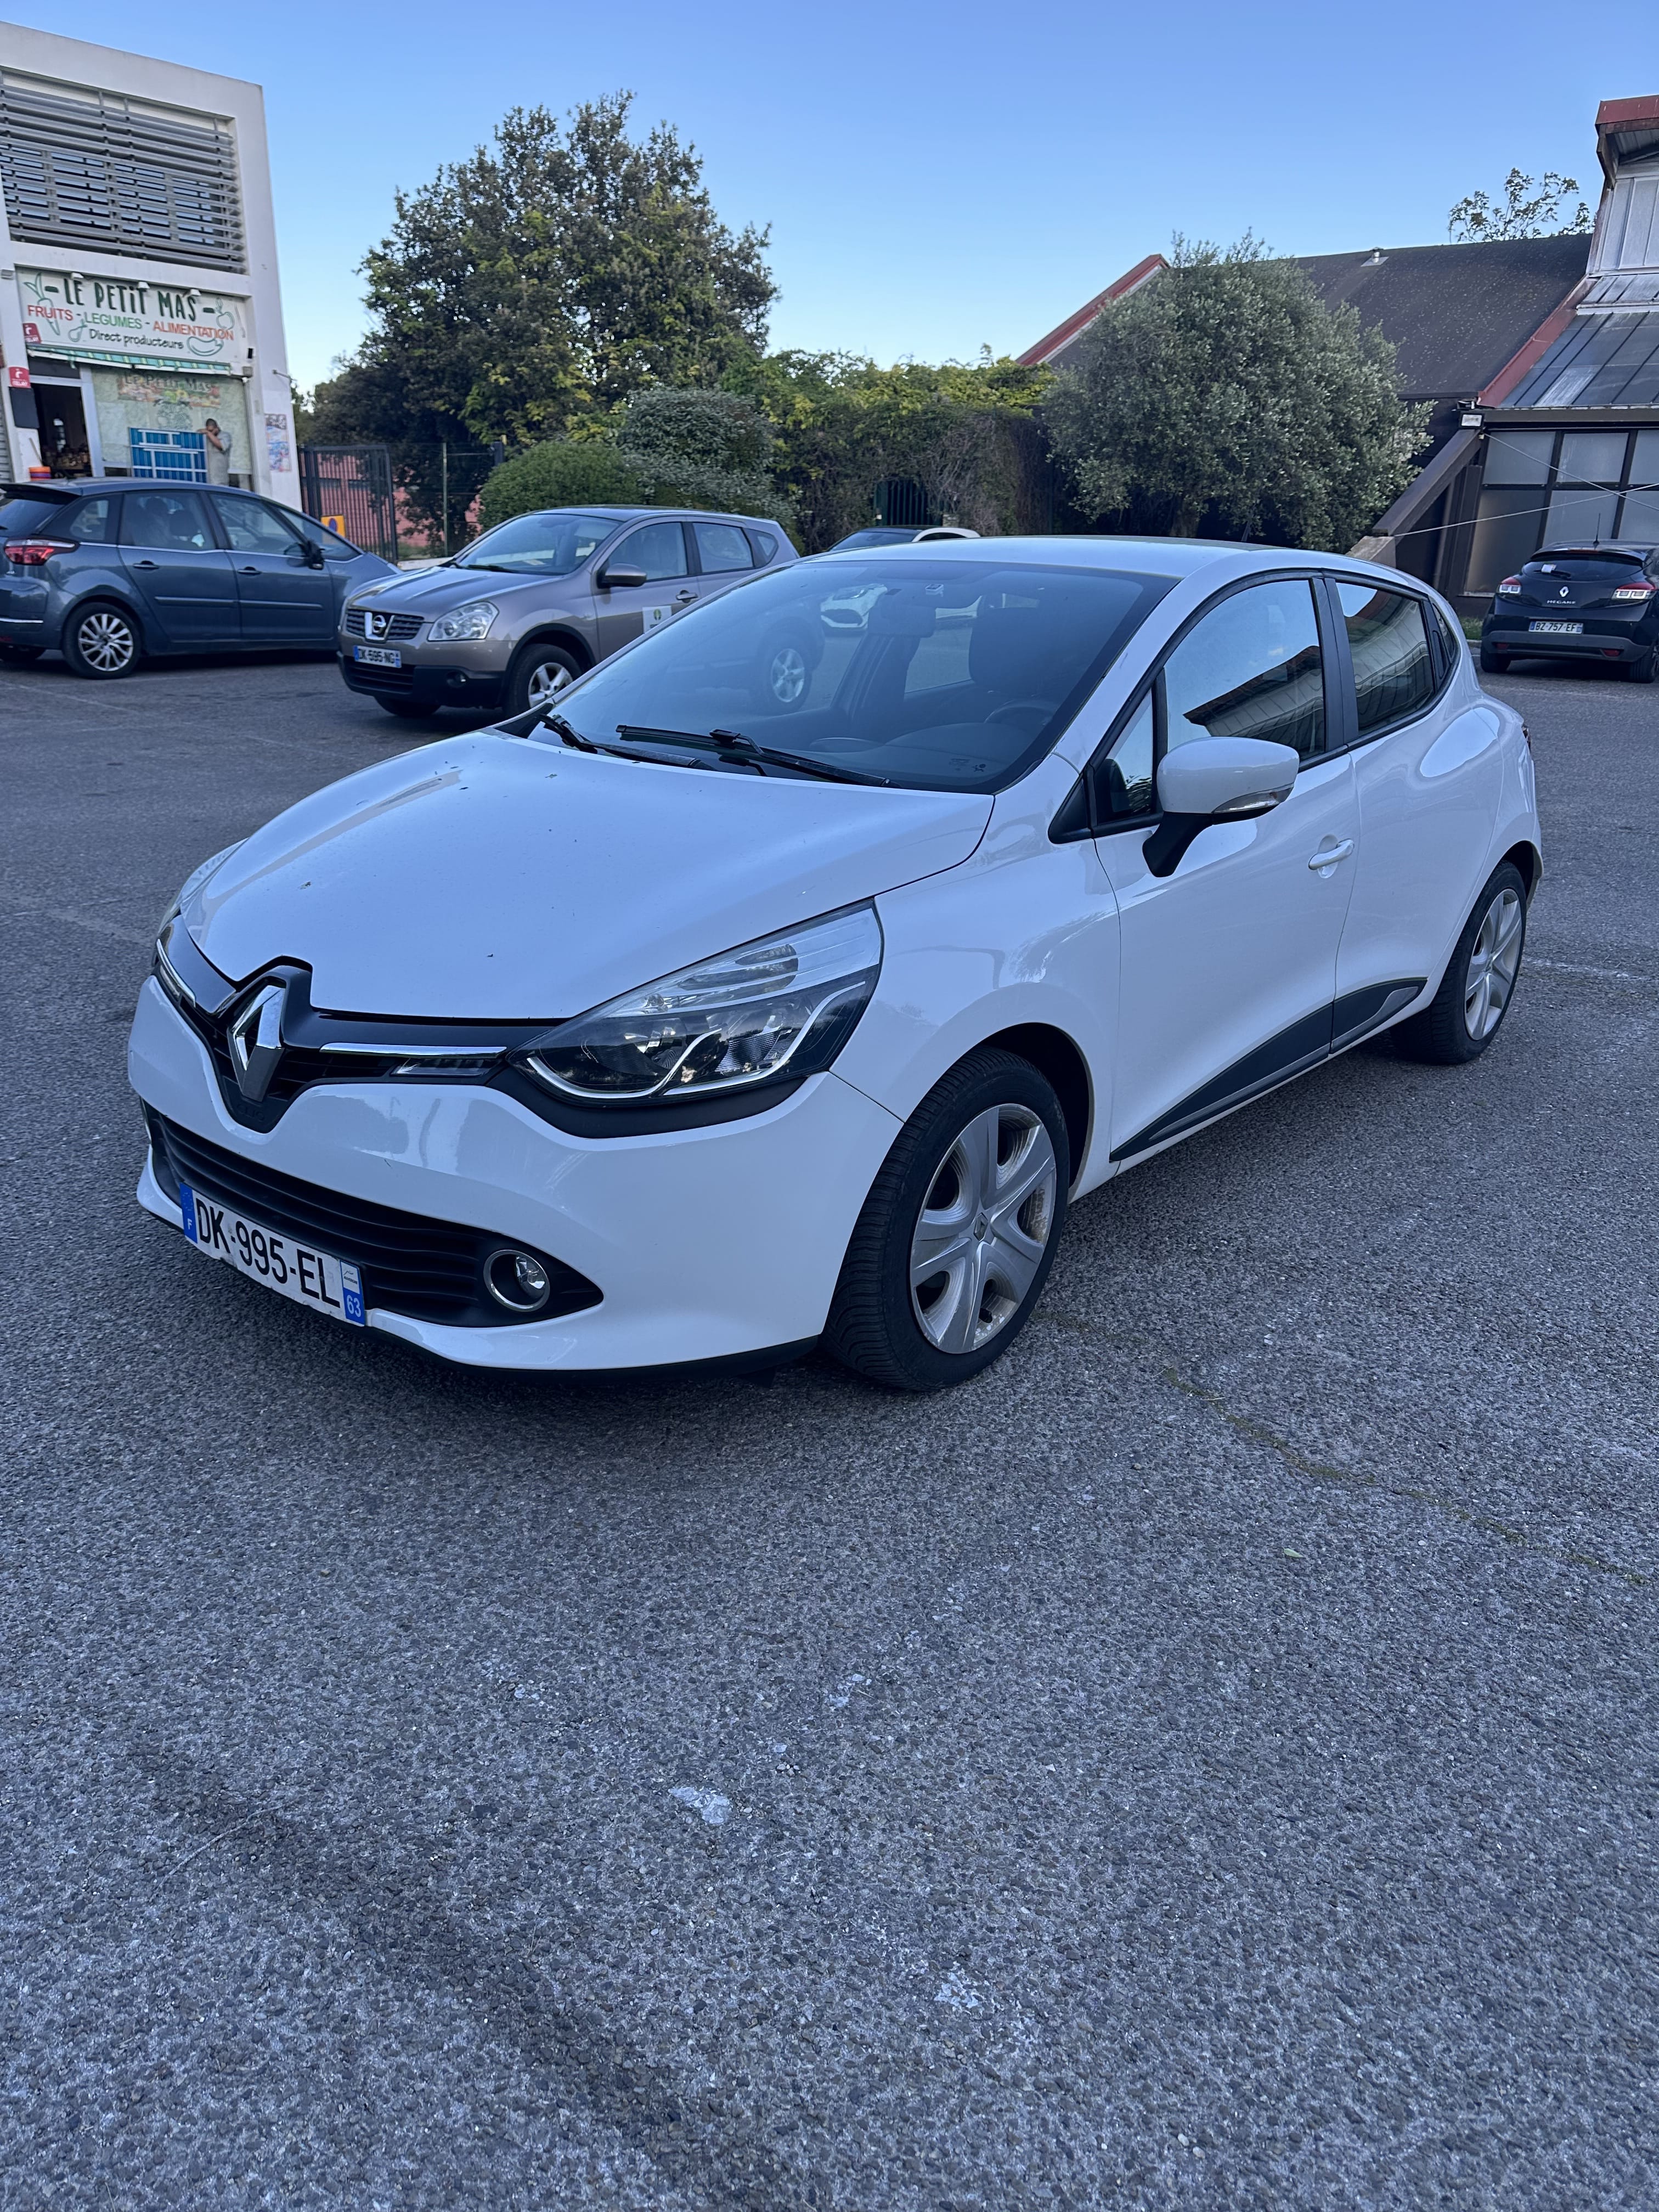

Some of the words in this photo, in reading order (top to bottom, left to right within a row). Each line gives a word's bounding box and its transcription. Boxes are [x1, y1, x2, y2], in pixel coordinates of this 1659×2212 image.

[64, 278, 84, 306] LE
[158, 291, 196, 321] MAS
[27, 305, 74, 321] FRUITS
[84, 312, 142, 329] LEGUMES
[153, 320, 234, 340] ALIMENTATION
[89, 329, 122, 342] Direct
[124, 335, 184, 349] producteurs
[187, 1218, 193, 1230] F
[196, 1198, 341, 1308] DK-995-EL
[346, 1295, 362, 1317] 63
